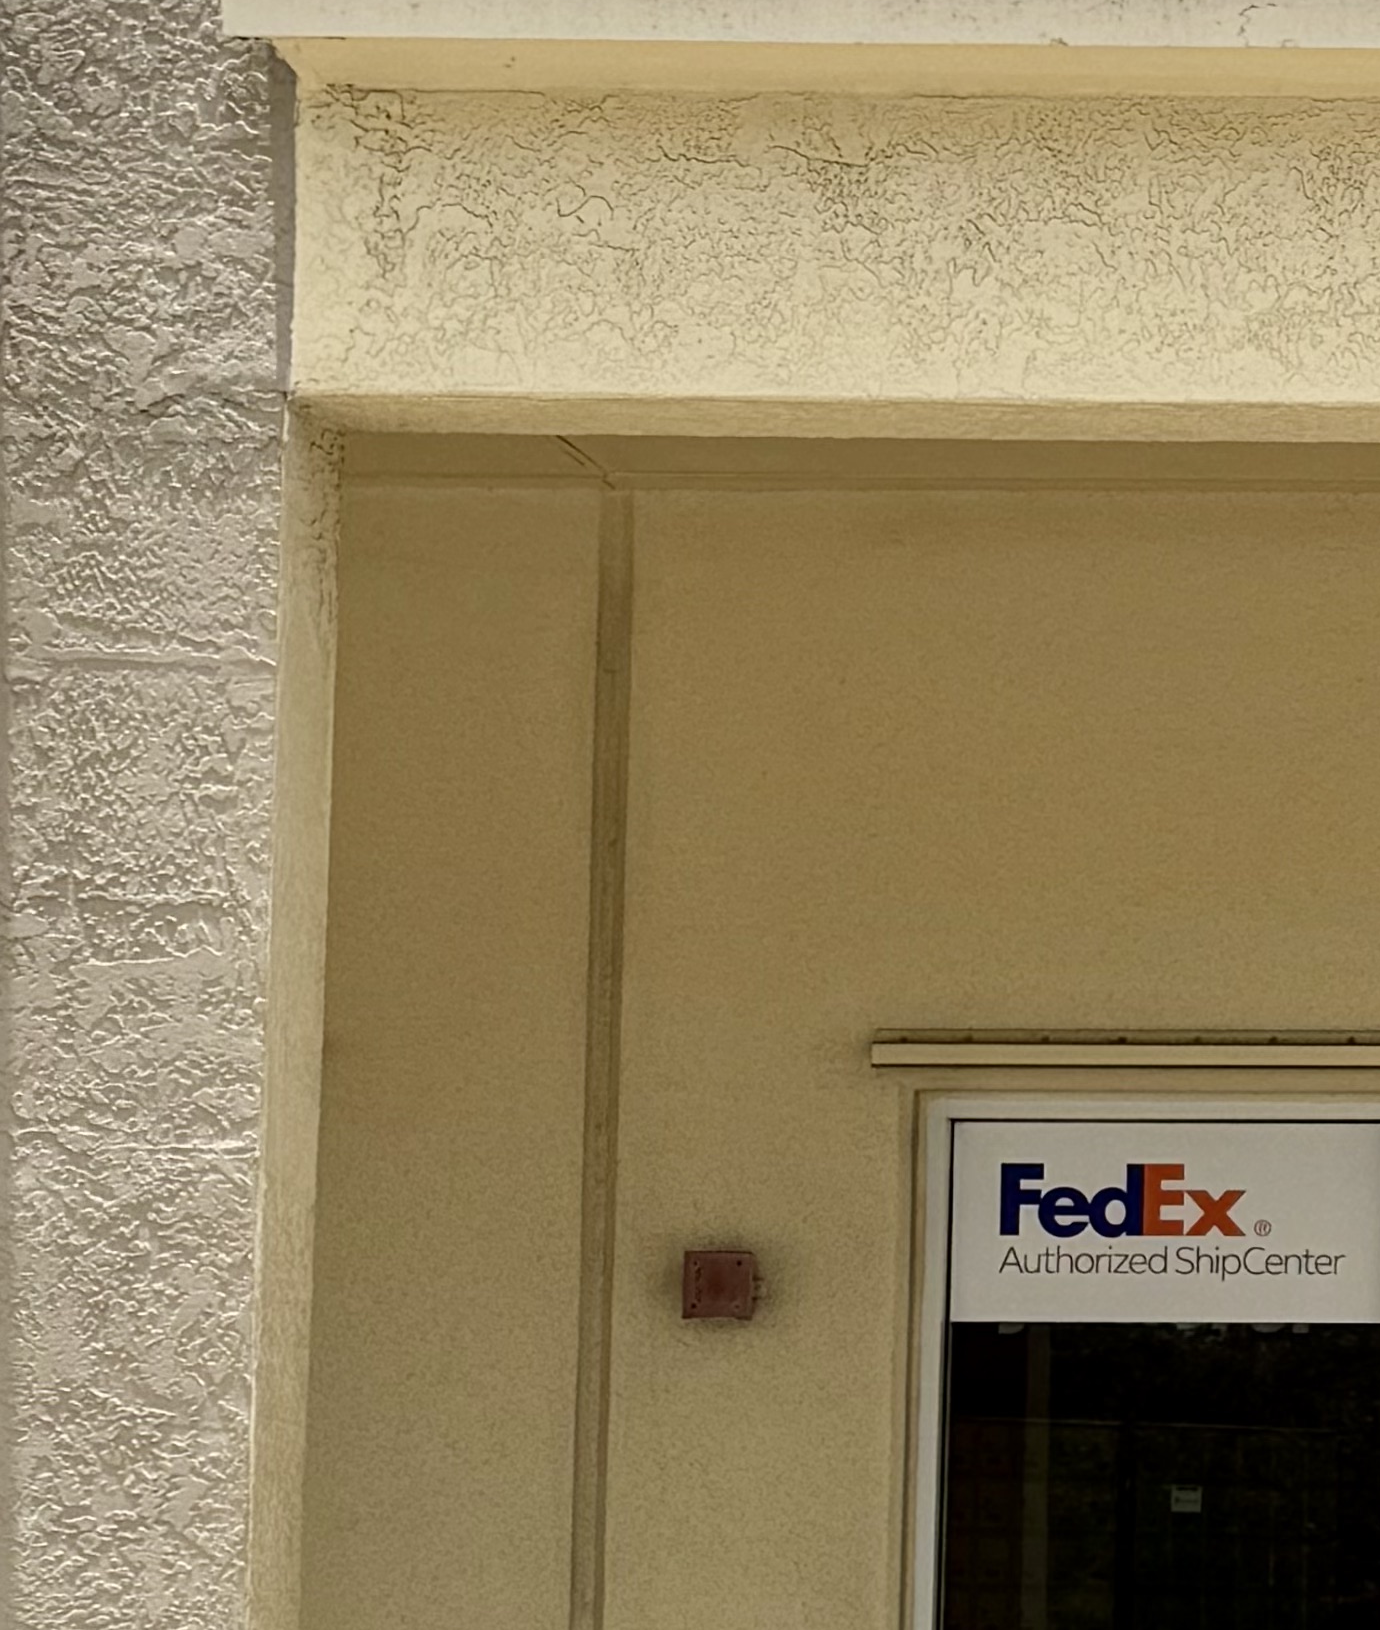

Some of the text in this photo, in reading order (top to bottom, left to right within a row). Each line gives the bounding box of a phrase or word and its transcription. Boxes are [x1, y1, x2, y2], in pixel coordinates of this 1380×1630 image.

[1000, 1162, 1247, 1238] FedEx
[998, 1245, 1345, 1281] Authorized ShipCenter
